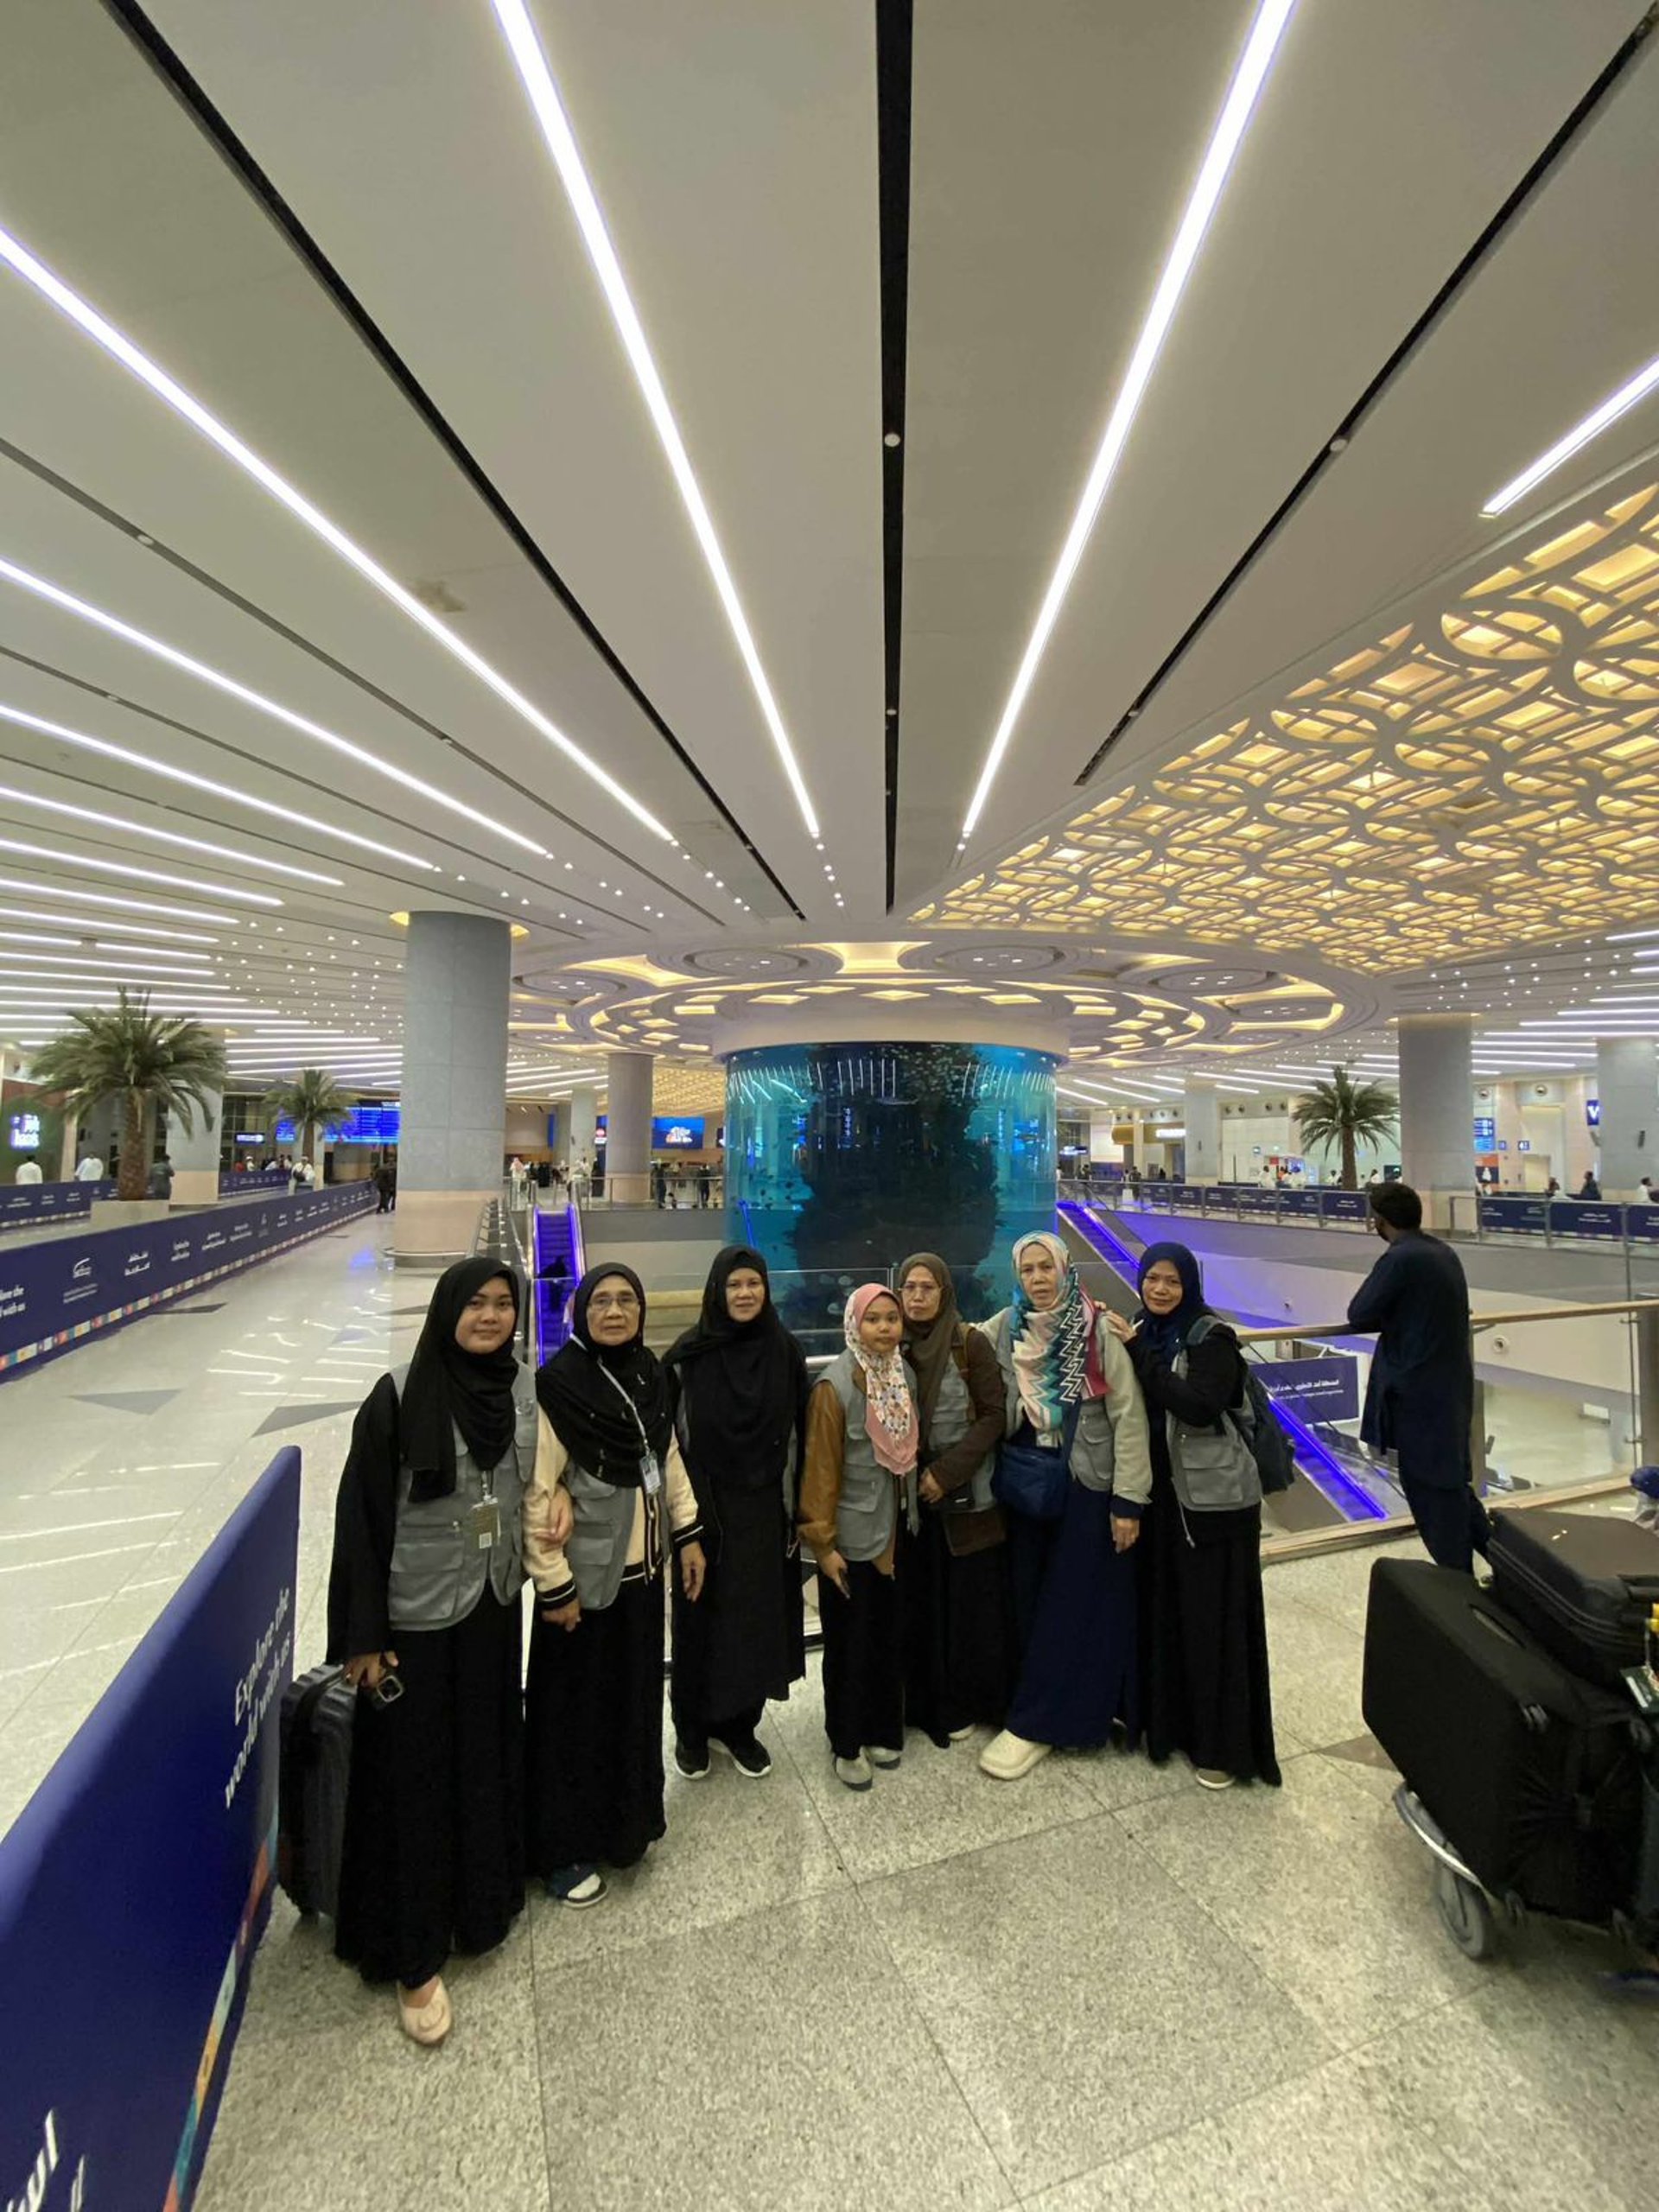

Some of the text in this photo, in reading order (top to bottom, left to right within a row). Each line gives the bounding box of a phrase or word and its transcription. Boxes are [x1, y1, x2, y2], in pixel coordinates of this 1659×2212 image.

[226, 1630, 291, 1809] world with us
[235, 1587, 289, 1726] Explore the
